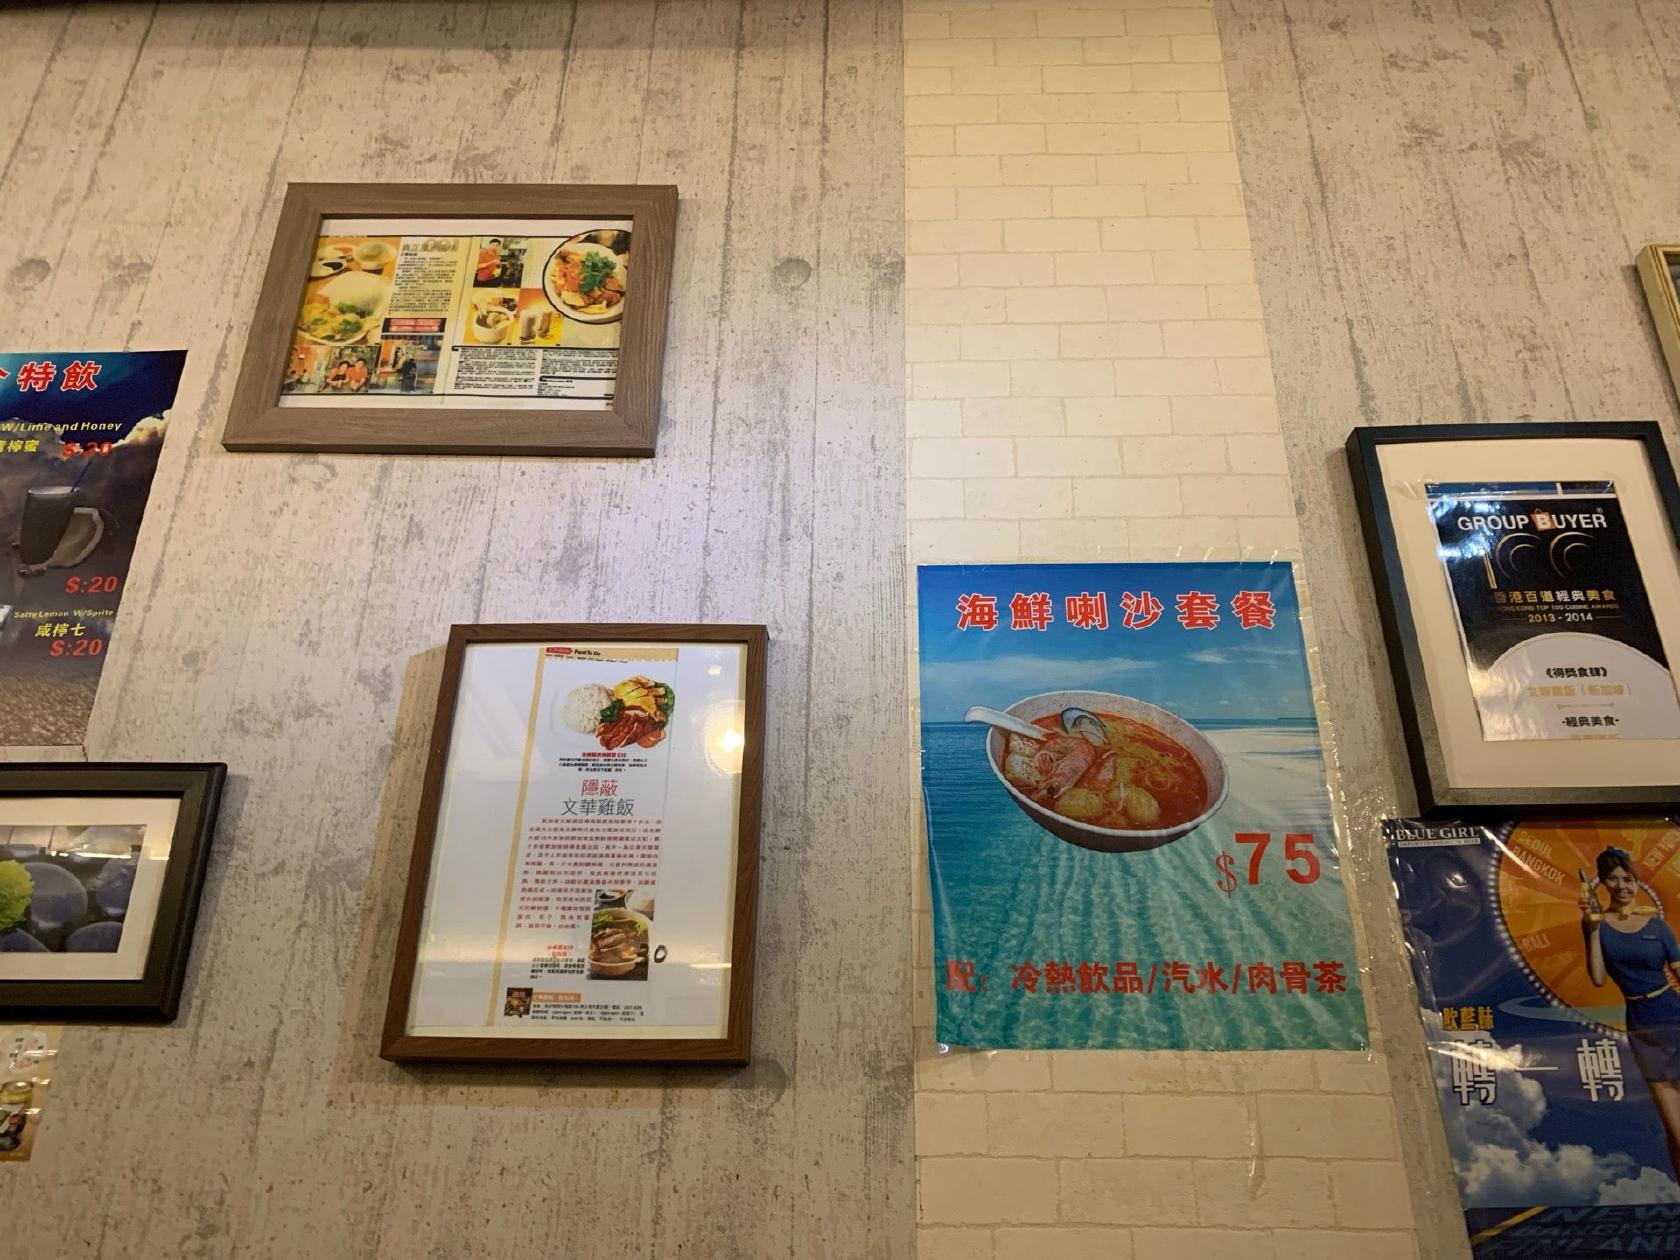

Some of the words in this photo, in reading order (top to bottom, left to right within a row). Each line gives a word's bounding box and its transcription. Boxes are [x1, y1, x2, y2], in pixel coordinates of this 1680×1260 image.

[0, 361, 102, 392] 特飲
[54, 422, 79, 431] and
[81, 421, 122, 432] Honey
[1457, 515, 1529, 531] GROUP
[1535, 512, 1607, 530] BUYER
[956, 591, 1277, 631] 海鮮喇沙套餐
[1528, 613, 1556, 623] 2013
[1564, 612, 1594, 622] 2014
[561, 798, 635, 816] 文華雞飯
[1396, 828, 1436, 840] BLUE
[1439, 826, 1479, 838] GIRL
[1517, 831, 1553, 860] SEOUL
[1215, 832, 1321, 898] $75
[1512, 846, 1566, 886] BANGKOK
[1011, 960, 1347, 994] 冷熱飲品/汽水/肉骨茶
